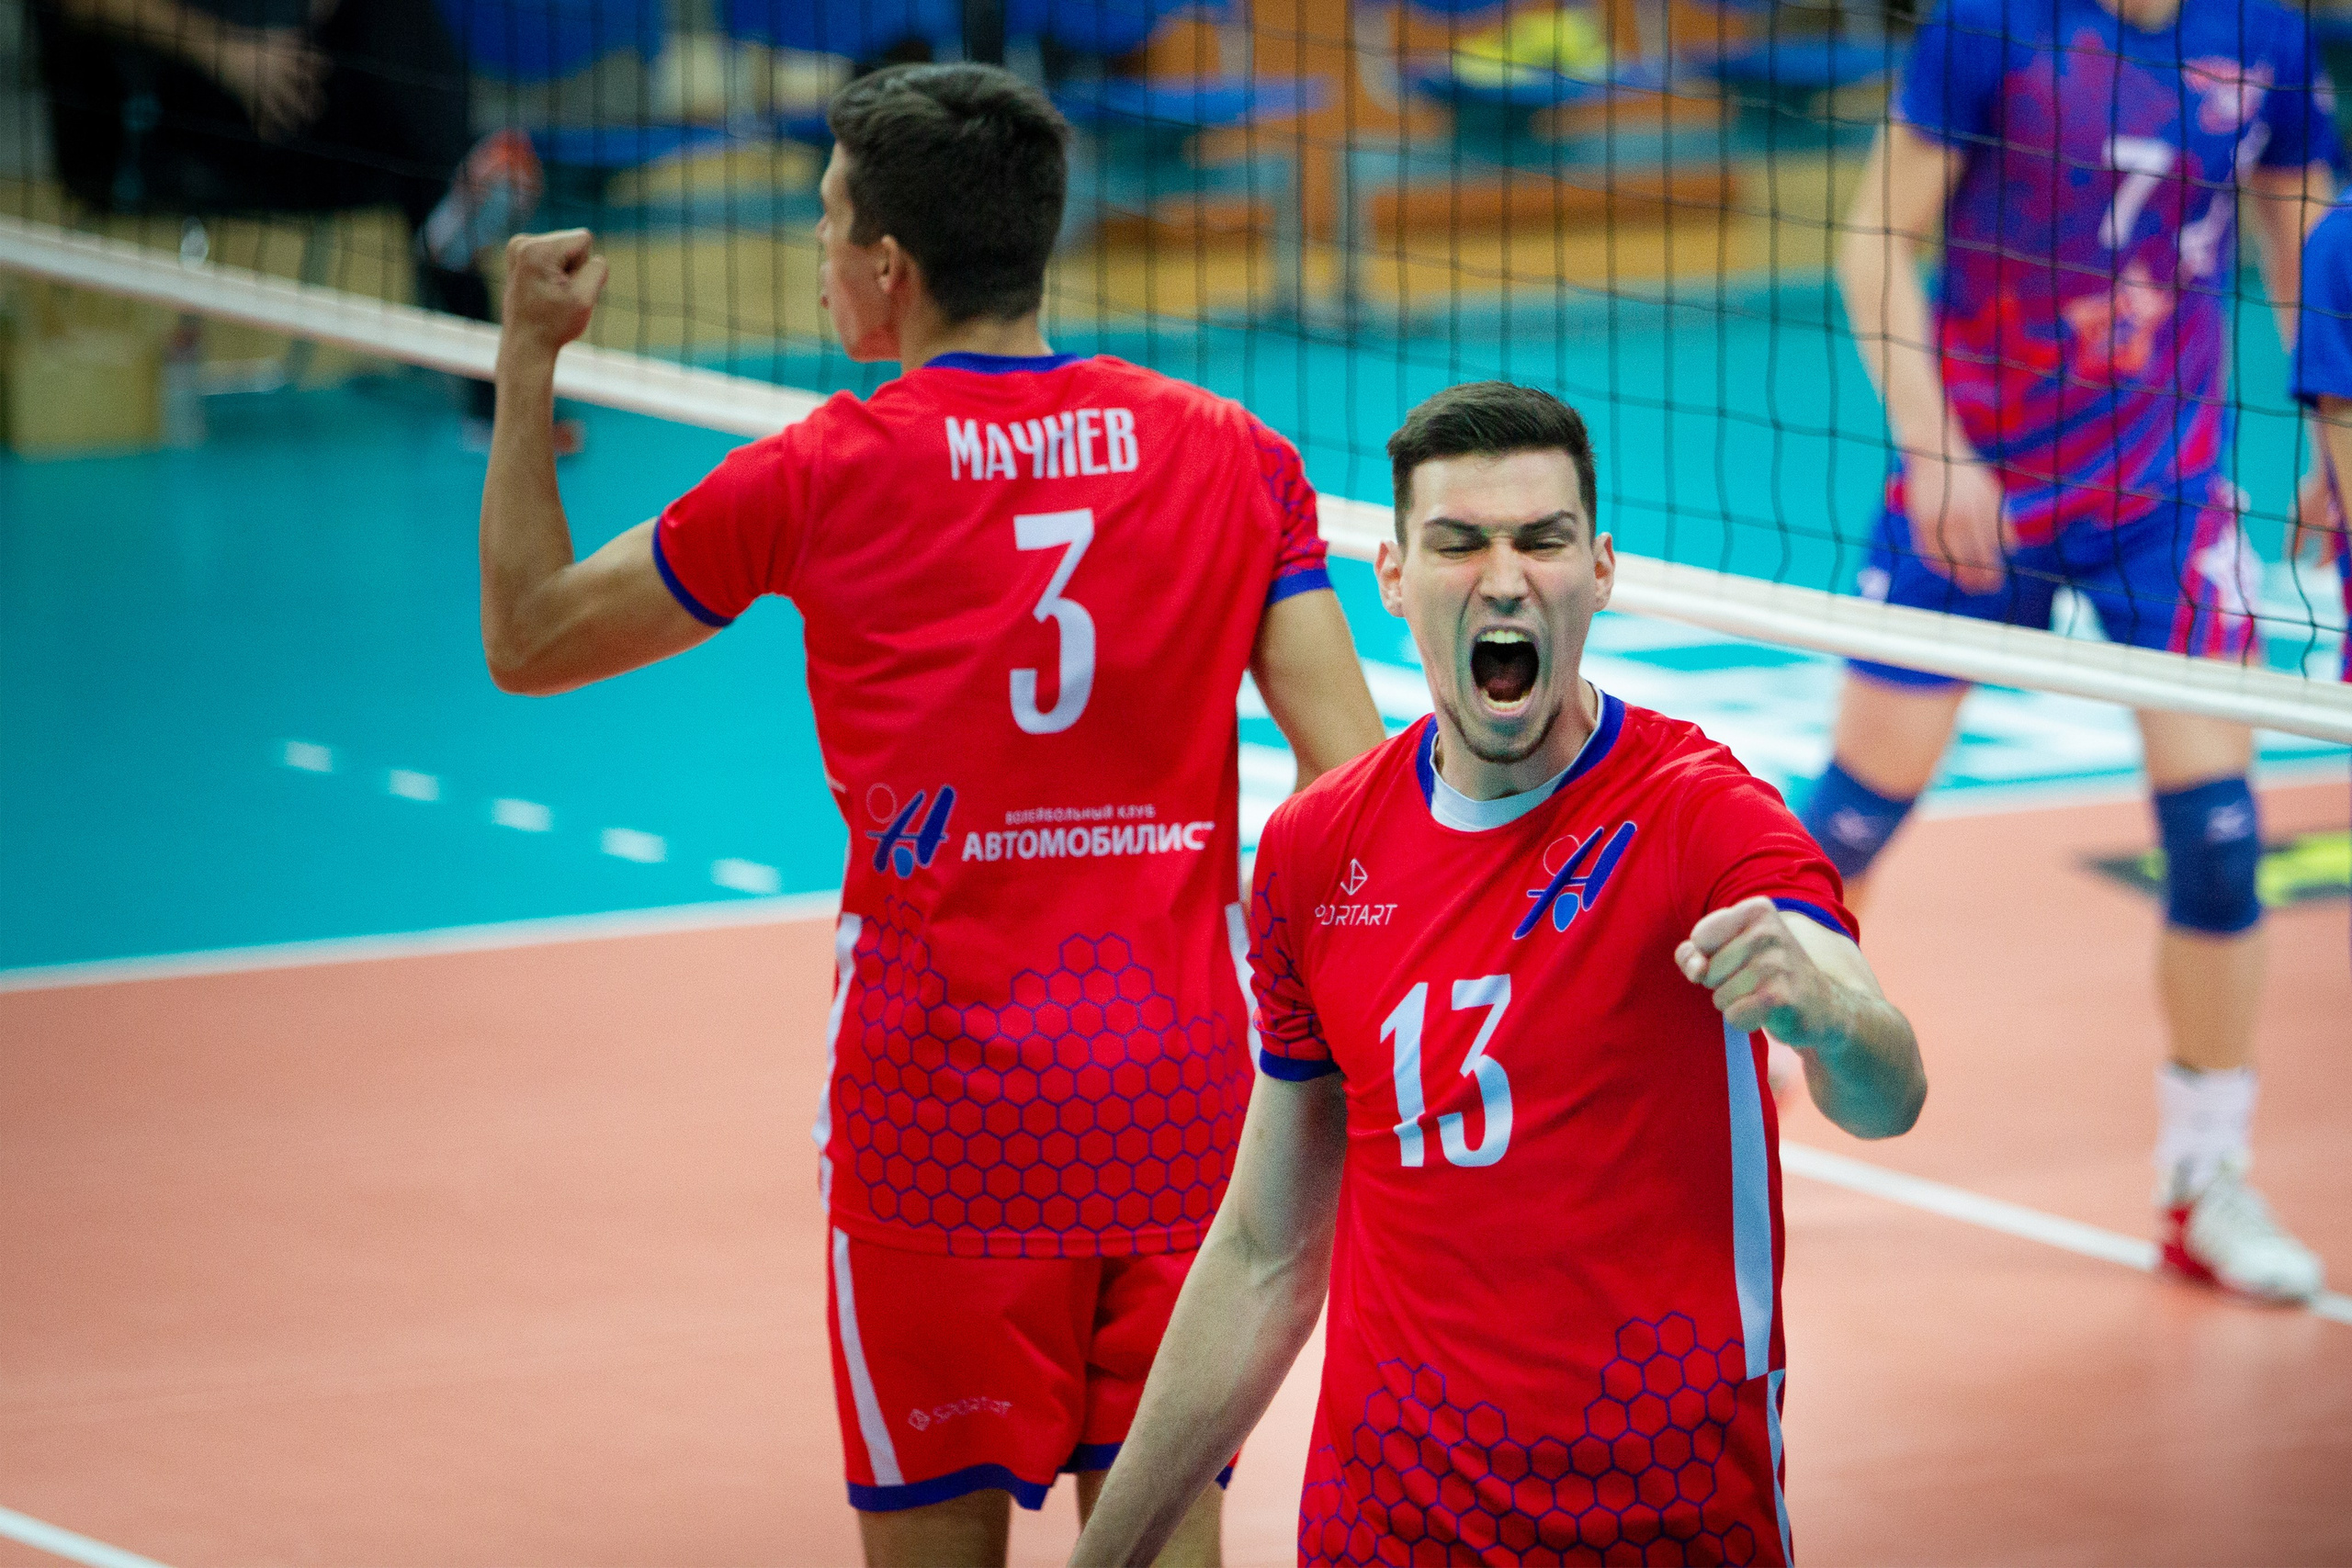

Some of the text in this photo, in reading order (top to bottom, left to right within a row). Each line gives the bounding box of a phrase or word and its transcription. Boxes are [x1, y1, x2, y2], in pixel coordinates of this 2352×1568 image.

[944, 407, 1139, 481] МАЧНЕВ
[1010, 508, 1096, 734] 3
[962, 821, 1215, 862] АВТОМОБИЛИС
[1380, 974, 1514, 1168] 13
